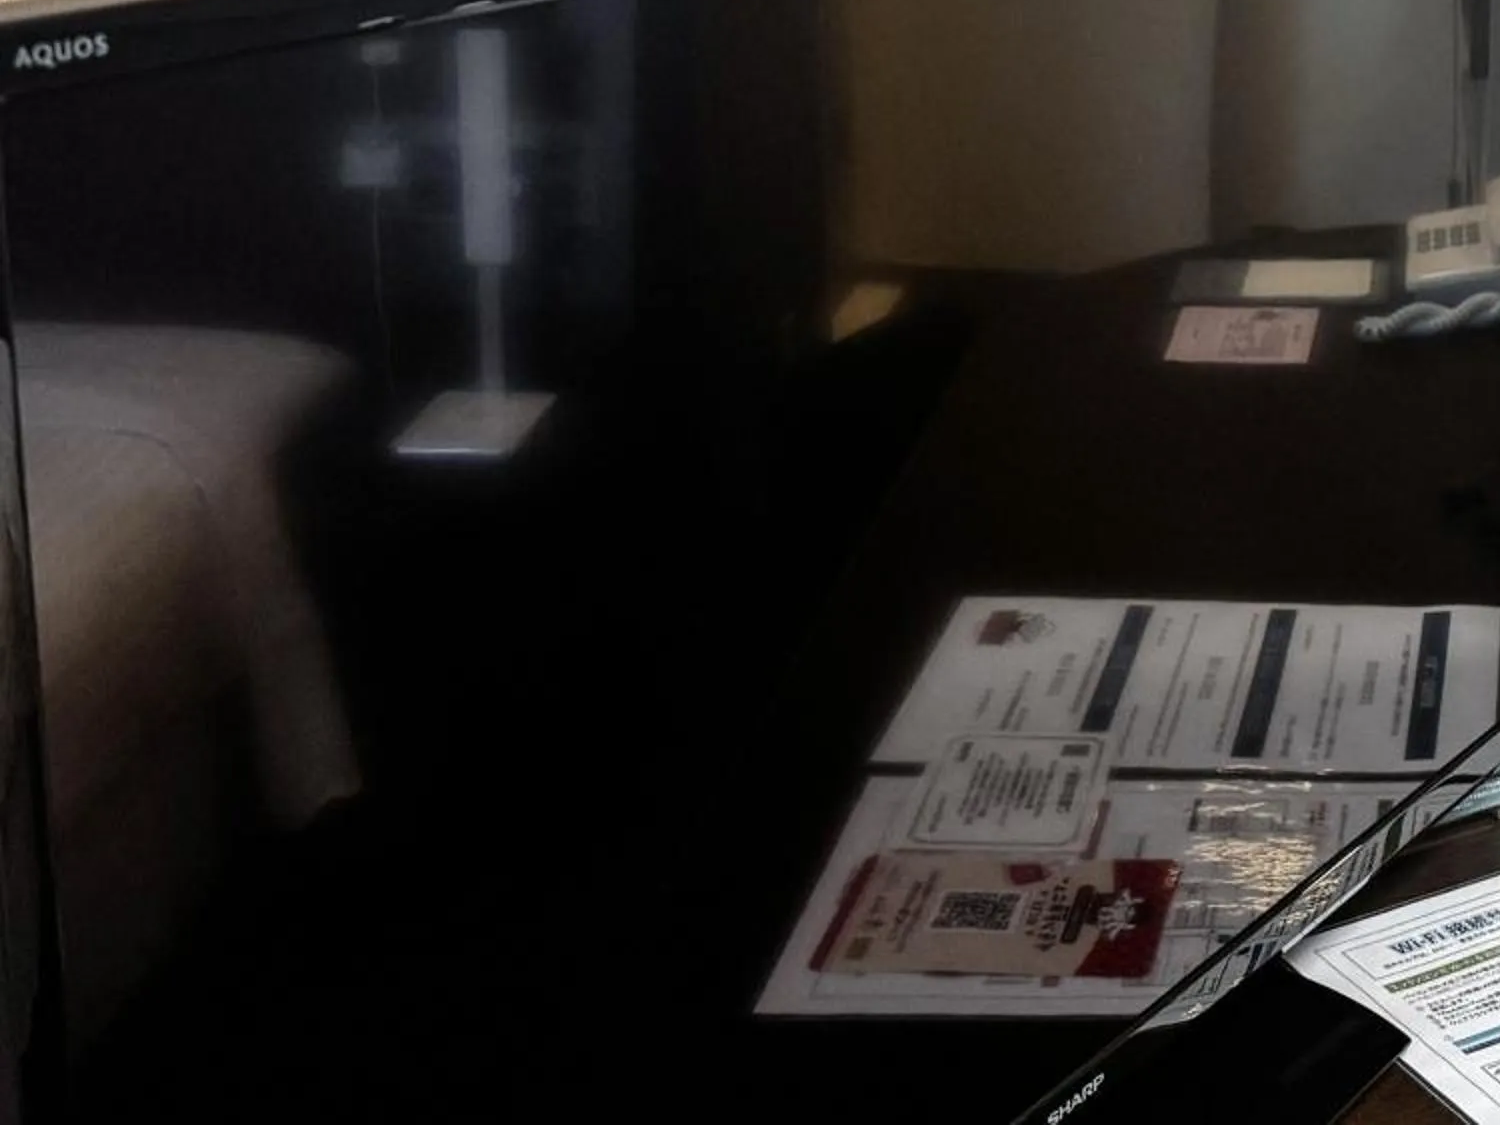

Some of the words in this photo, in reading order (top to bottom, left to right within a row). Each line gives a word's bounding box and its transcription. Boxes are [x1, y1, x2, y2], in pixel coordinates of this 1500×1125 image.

[14, 32, 110, 69] AQUOS
[1390, 931, 1445, 955] Wi-Fi
[1047, 1072, 1104, 1125] SHARP
